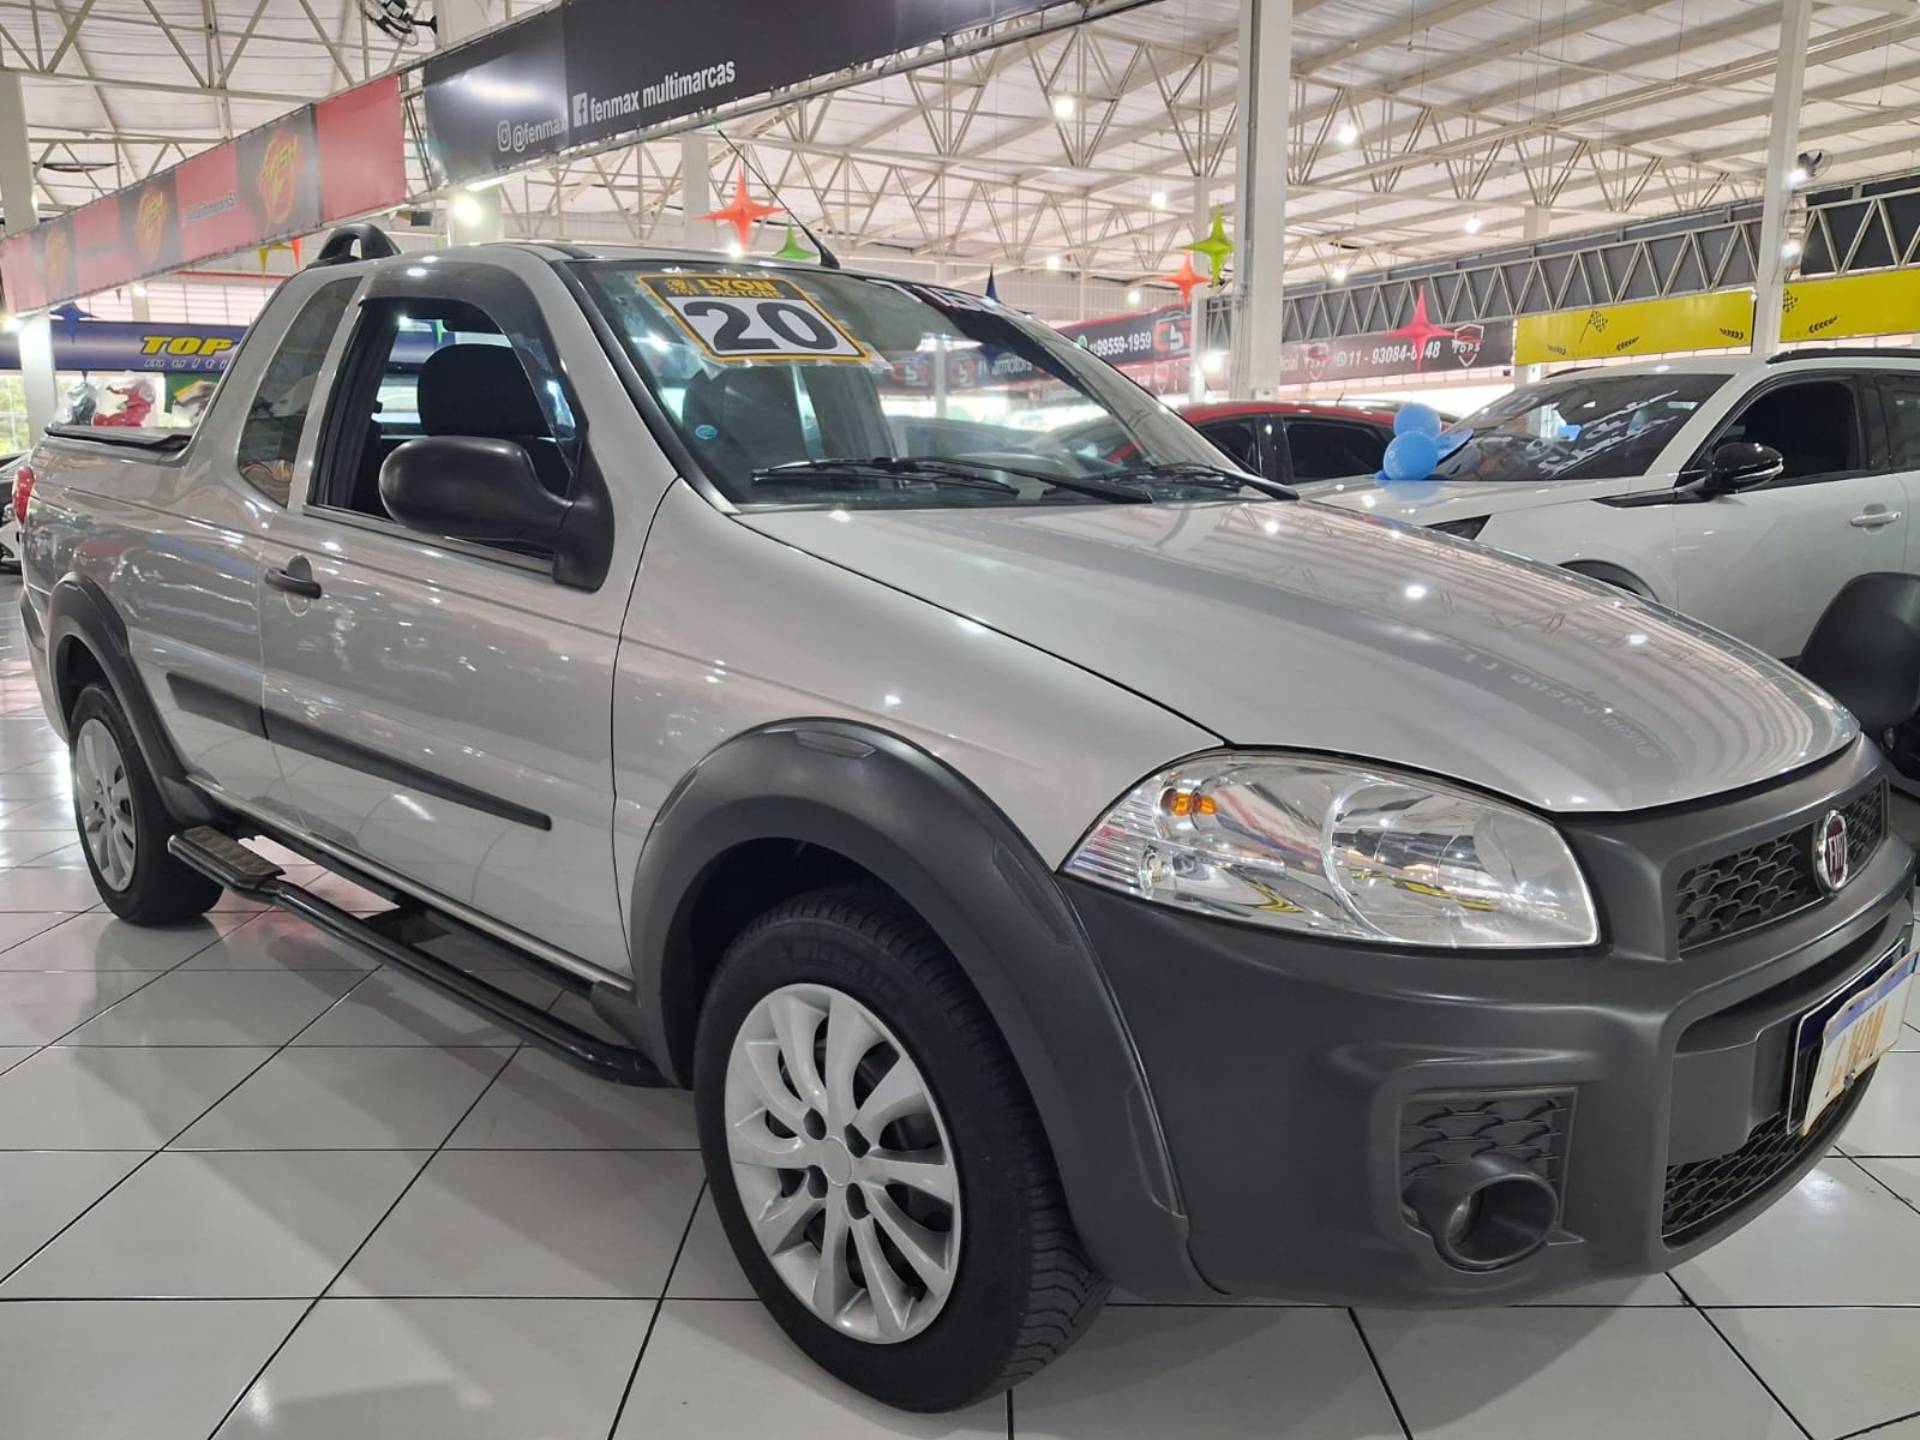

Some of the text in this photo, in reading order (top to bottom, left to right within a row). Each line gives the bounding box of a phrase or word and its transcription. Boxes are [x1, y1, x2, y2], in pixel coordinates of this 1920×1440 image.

[589, 60, 736, 123] fenmax multimarcas
[697, 278, 777, 291] LYON
[709, 289, 786, 299] MOTORS
[683, 301, 838, 350] 20
[141, 335, 233, 356] TOP
